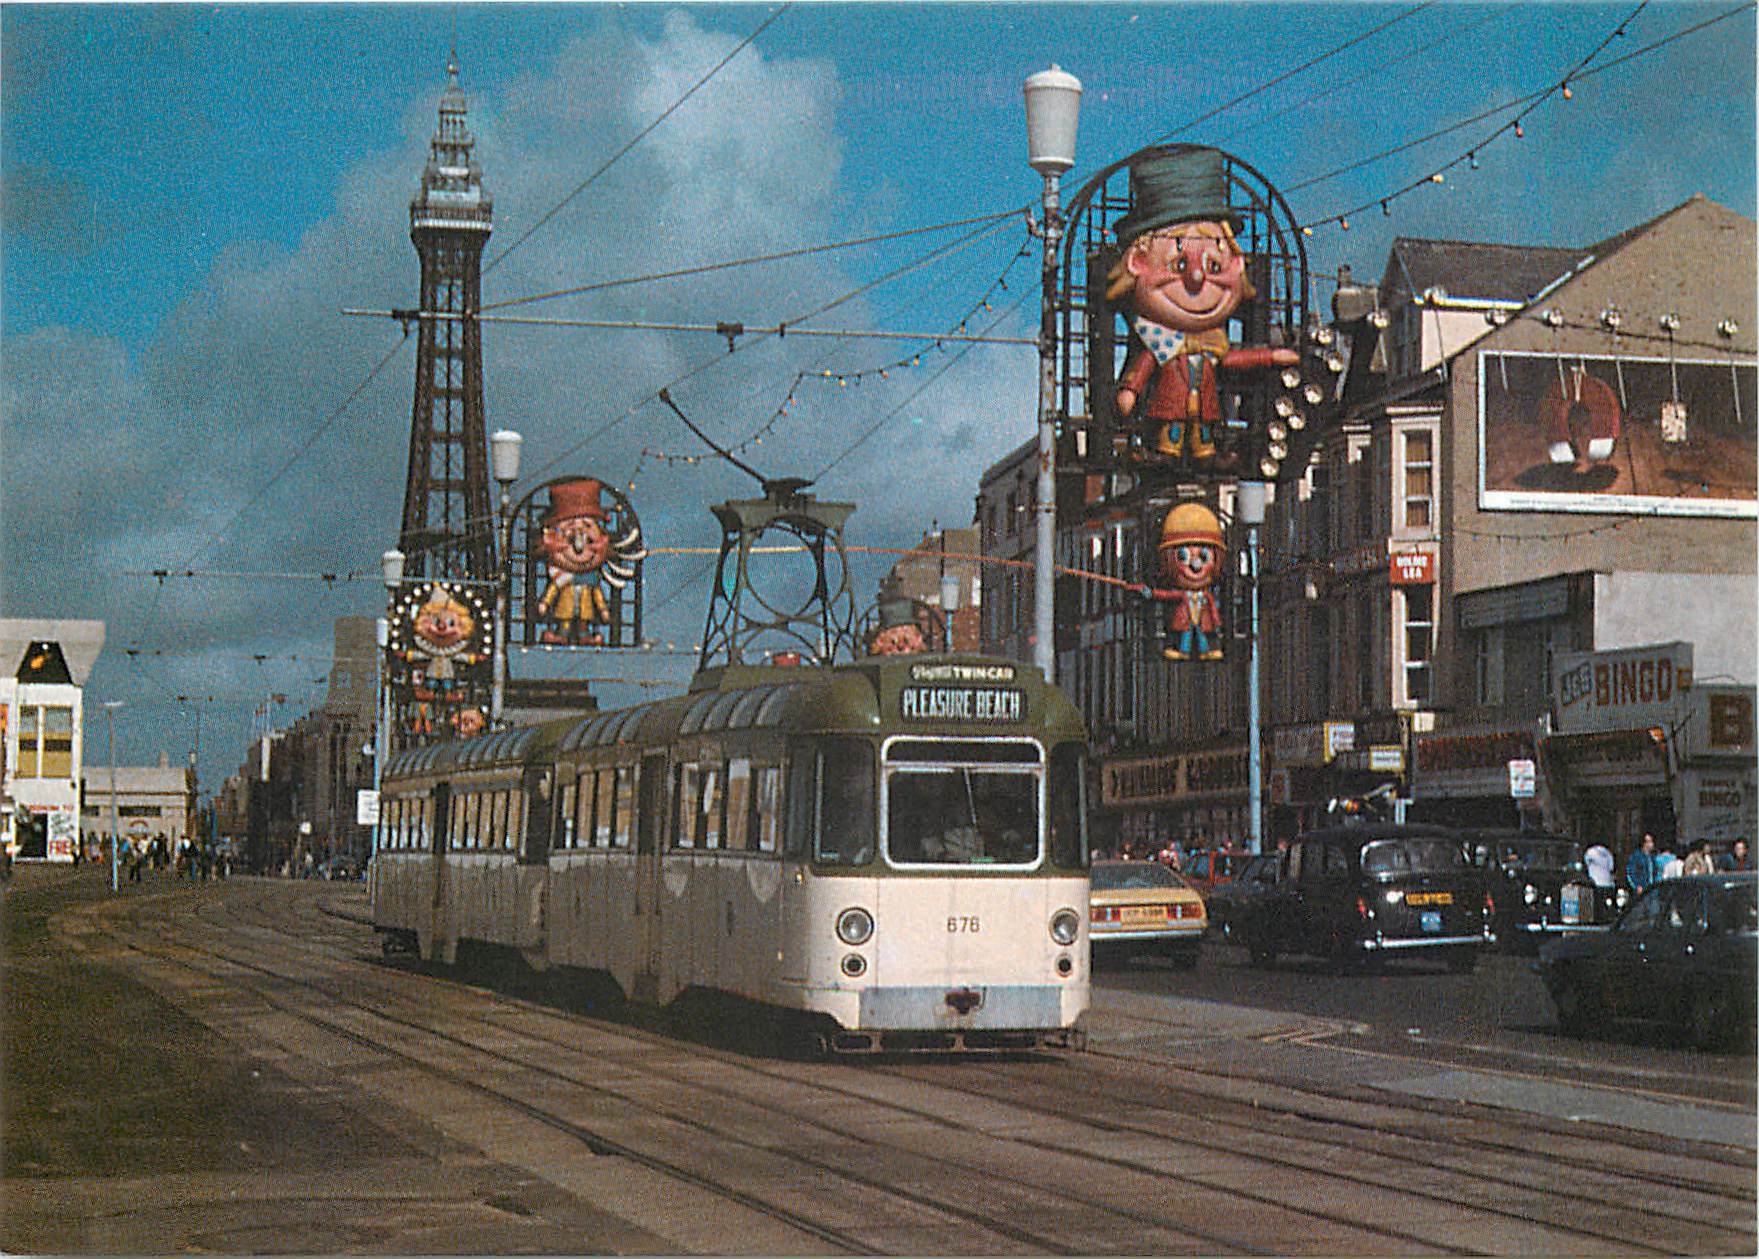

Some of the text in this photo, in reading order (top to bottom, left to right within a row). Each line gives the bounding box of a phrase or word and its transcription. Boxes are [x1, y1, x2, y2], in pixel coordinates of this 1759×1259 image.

[1595, 658, 1673, 707] BINGO
[903, 689, 1020, 720] PLEASURE BEACH
[48, 839, 70, 855] FRE
